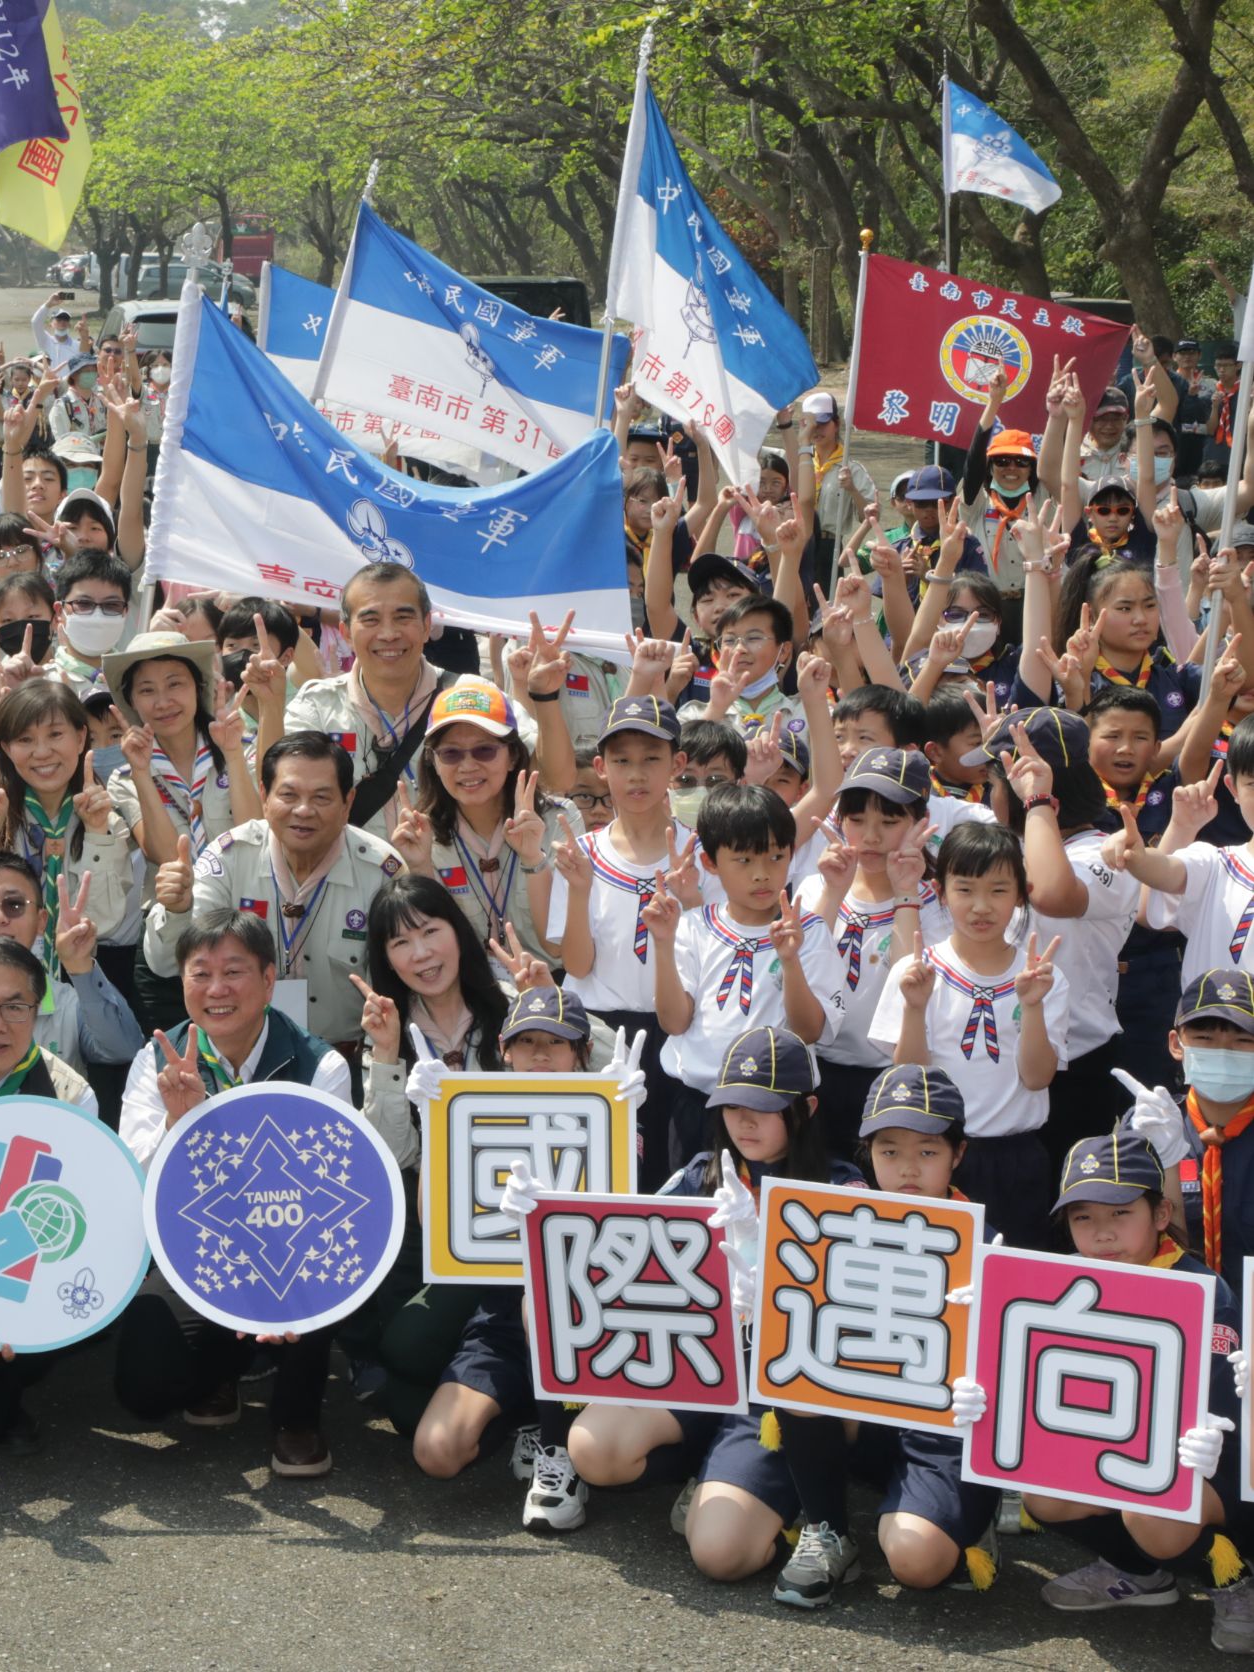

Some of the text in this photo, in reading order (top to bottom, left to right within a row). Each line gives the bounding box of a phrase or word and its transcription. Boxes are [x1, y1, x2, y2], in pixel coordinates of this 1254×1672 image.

[908, 271, 1086, 337] 臺南市天主教
[243, 1188, 302, 1205] TAINAN
[246, 1204, 305, 1228] 400
[540, 1211, 724, 1391] 際
[766, 1198, 960, 1411] 邁
[991, 1276, 1187, 1496] 向
